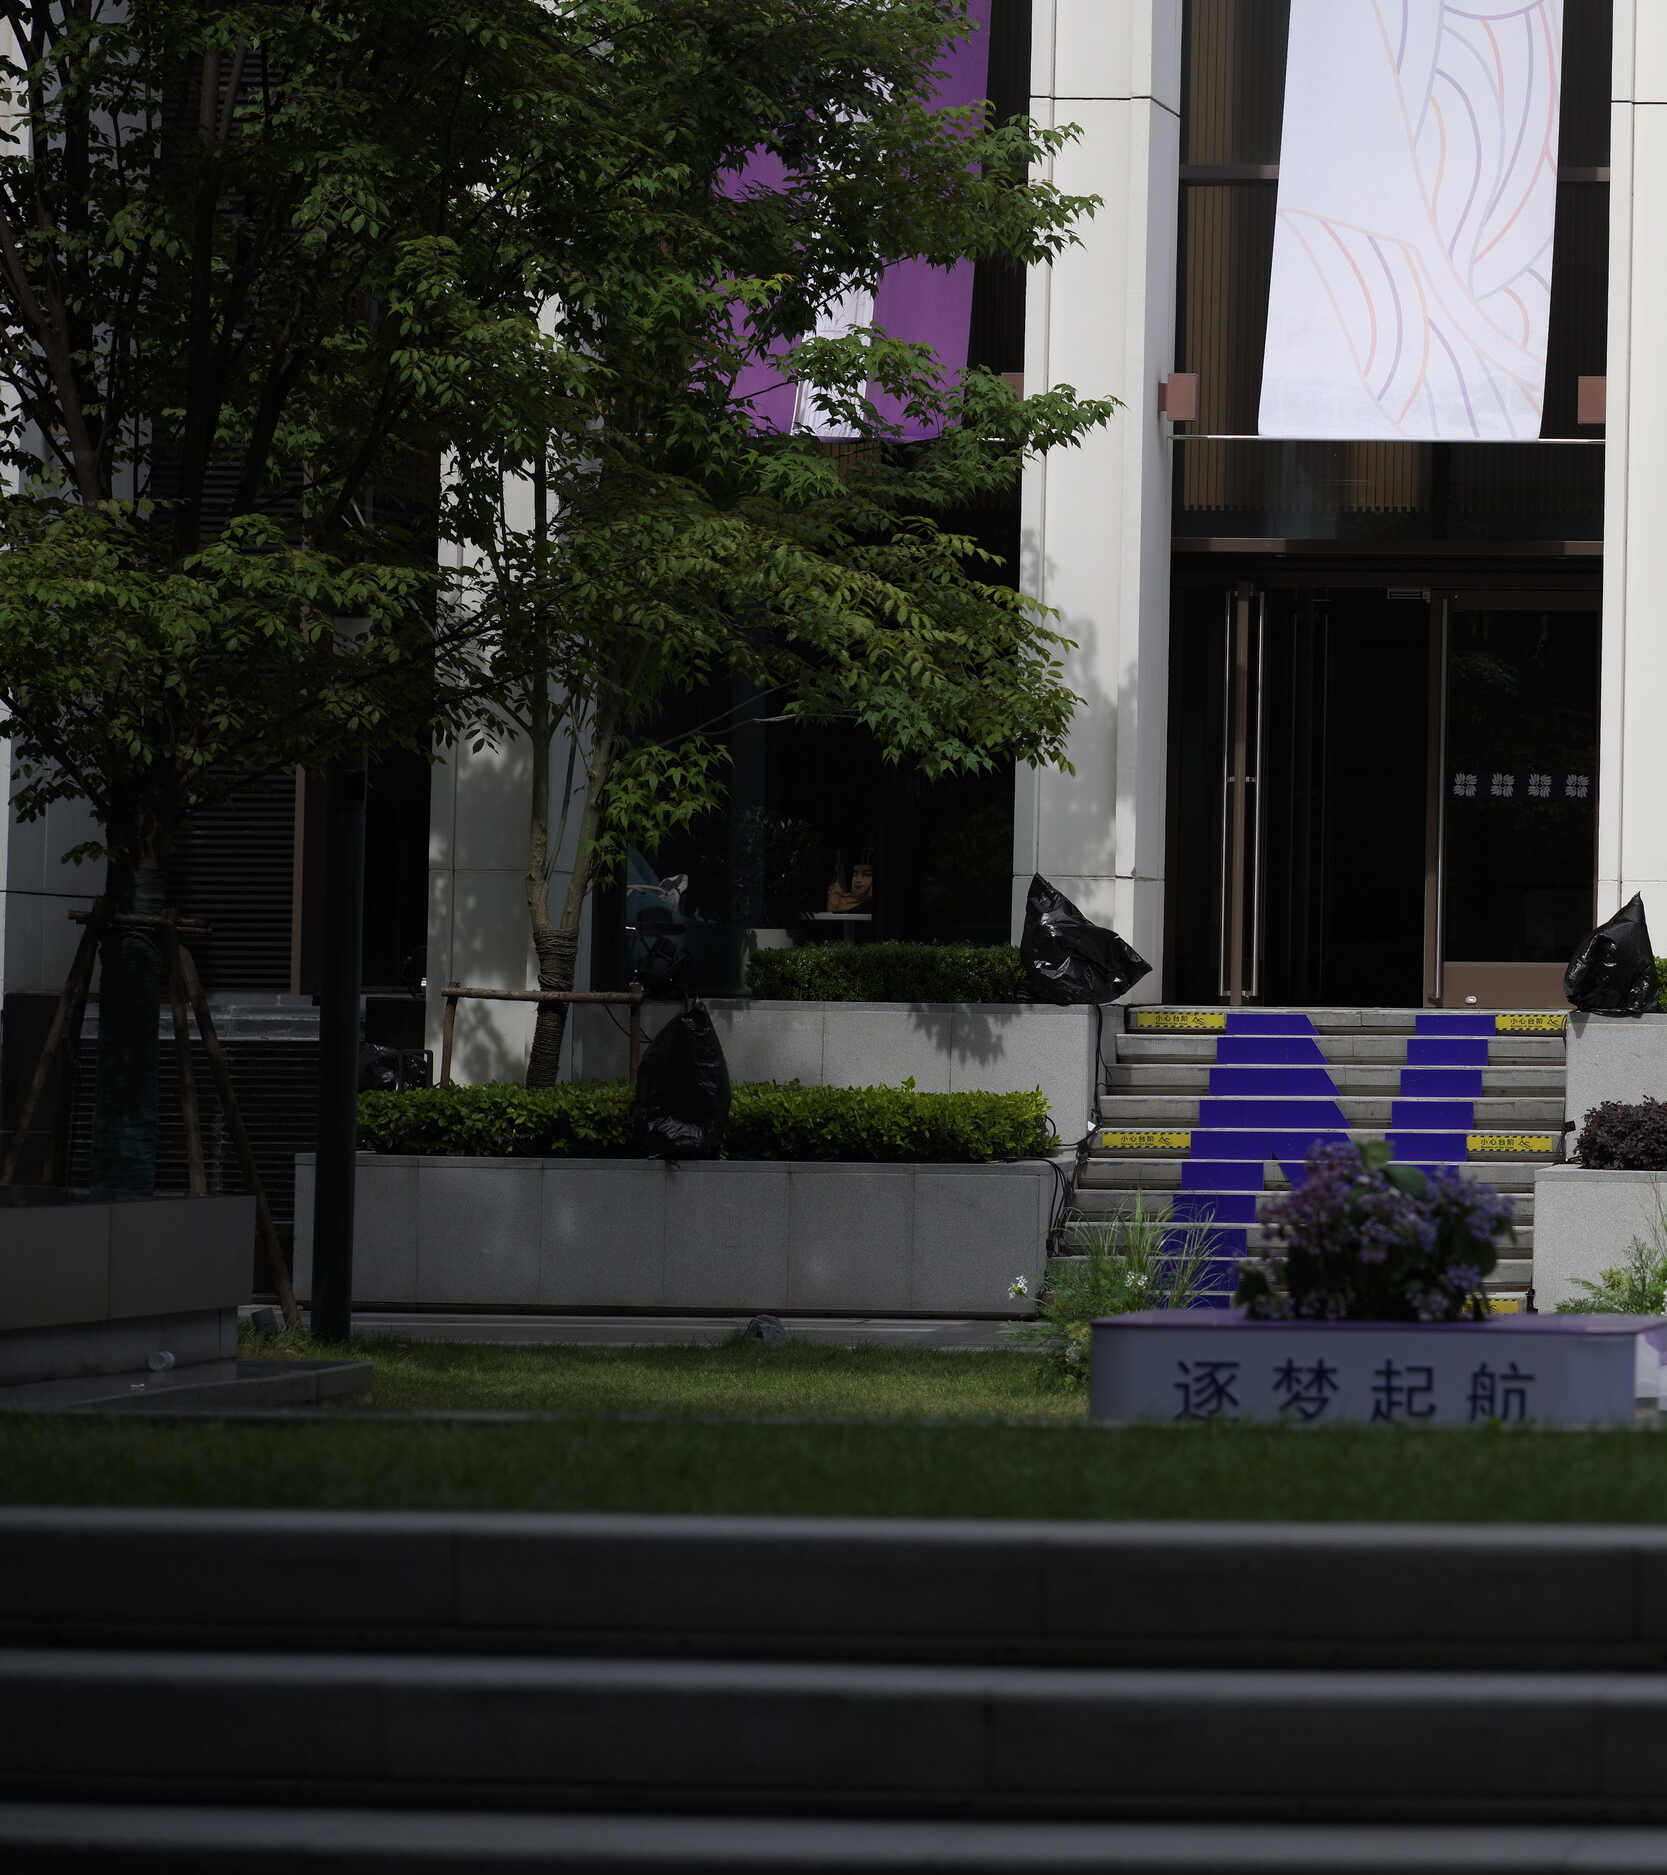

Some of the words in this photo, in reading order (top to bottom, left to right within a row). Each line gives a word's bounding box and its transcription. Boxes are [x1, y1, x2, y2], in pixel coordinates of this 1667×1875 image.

[1155, 1014, 1188, 1022] 小心台阶
[1120, 1135, 1155, 1143] 小心台阶
[1174, 1358, 1537, 1424] 逐梦起航
